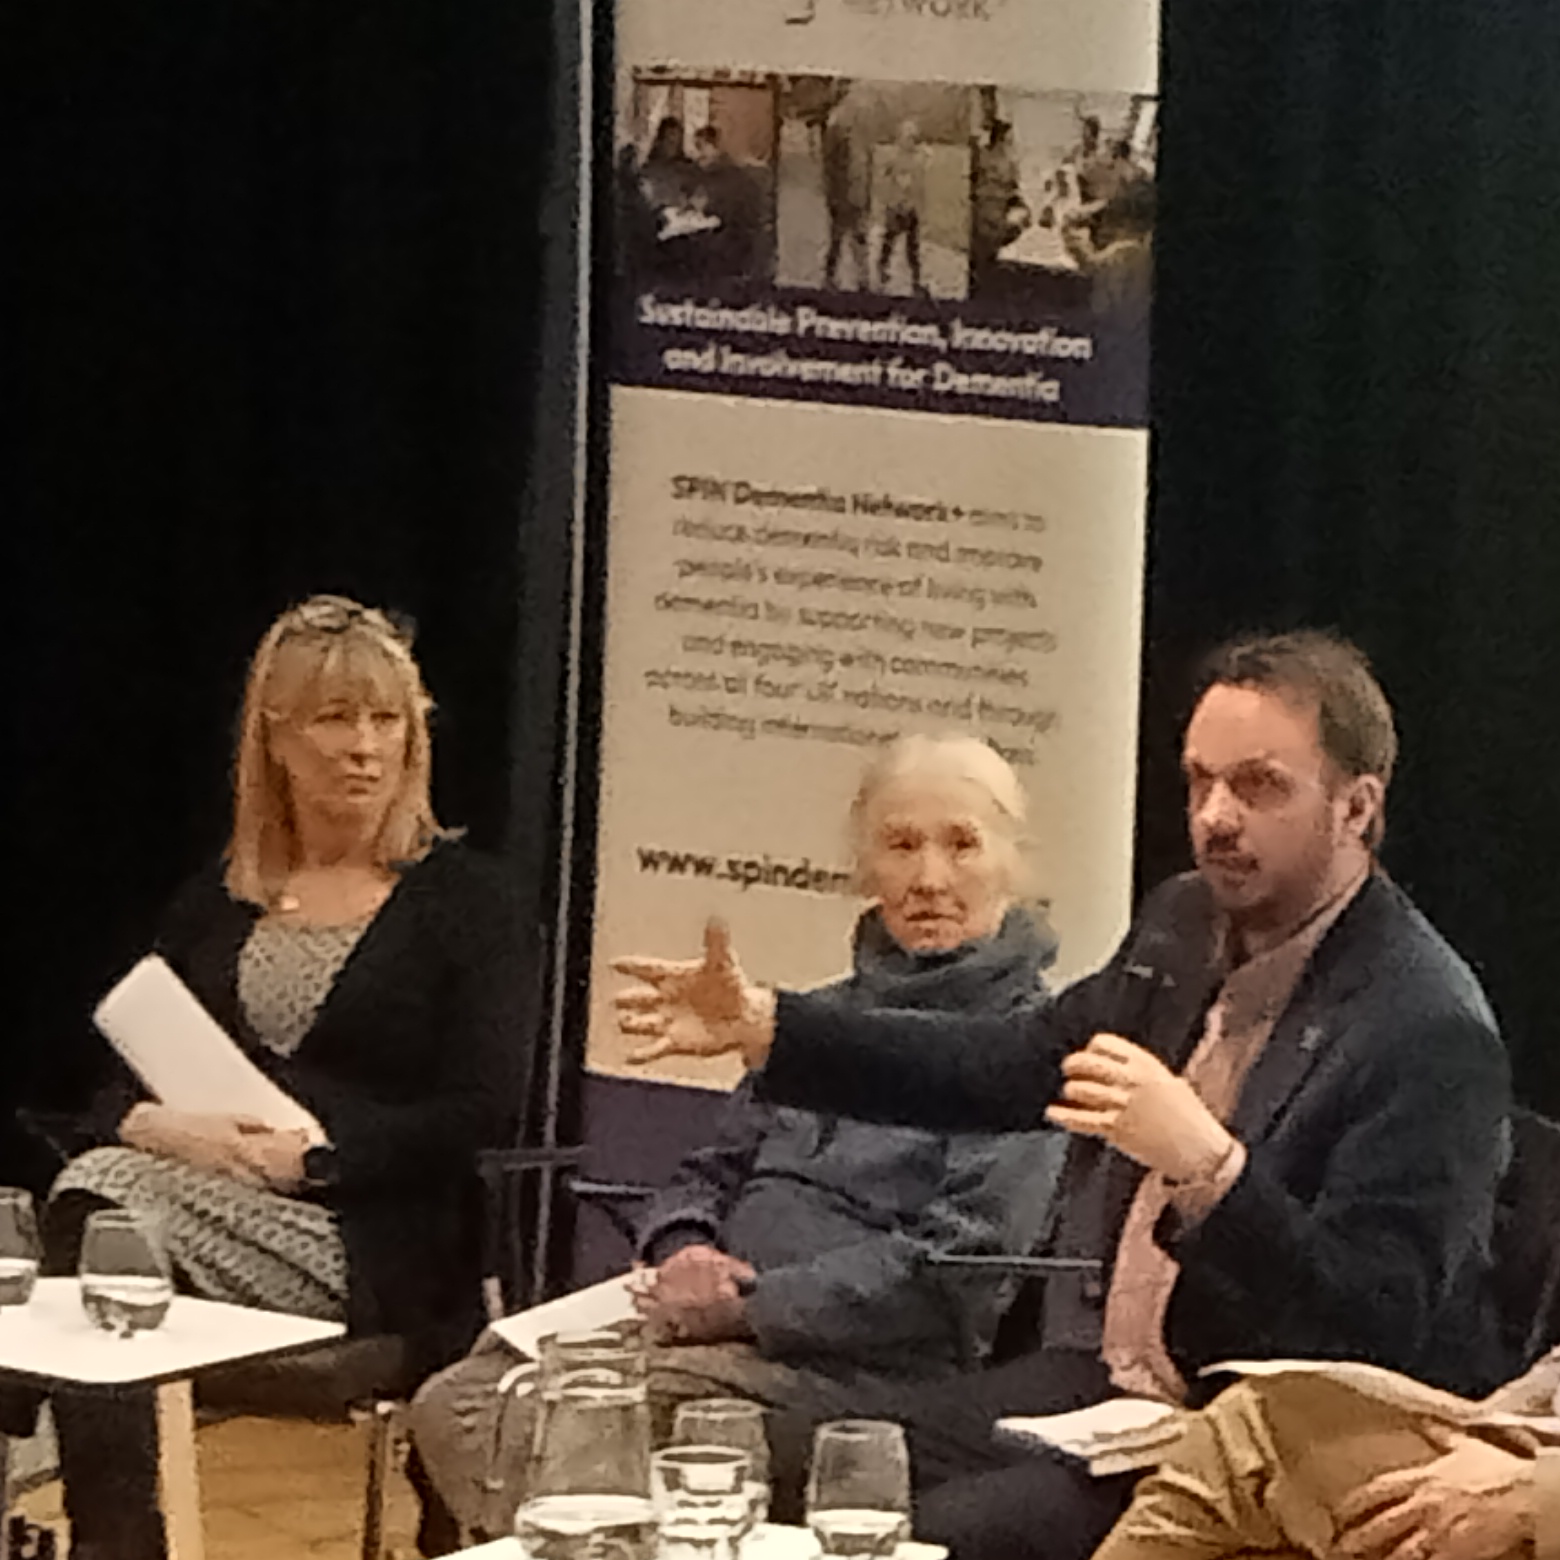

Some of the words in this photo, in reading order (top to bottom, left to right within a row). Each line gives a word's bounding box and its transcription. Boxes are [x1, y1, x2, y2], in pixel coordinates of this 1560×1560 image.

[638, 294, 793, 336] Sustainable
[662, 344, 717, 372] and
[886, 356, 931, 387] for
[933, 362, 1061, 401] Dementia
